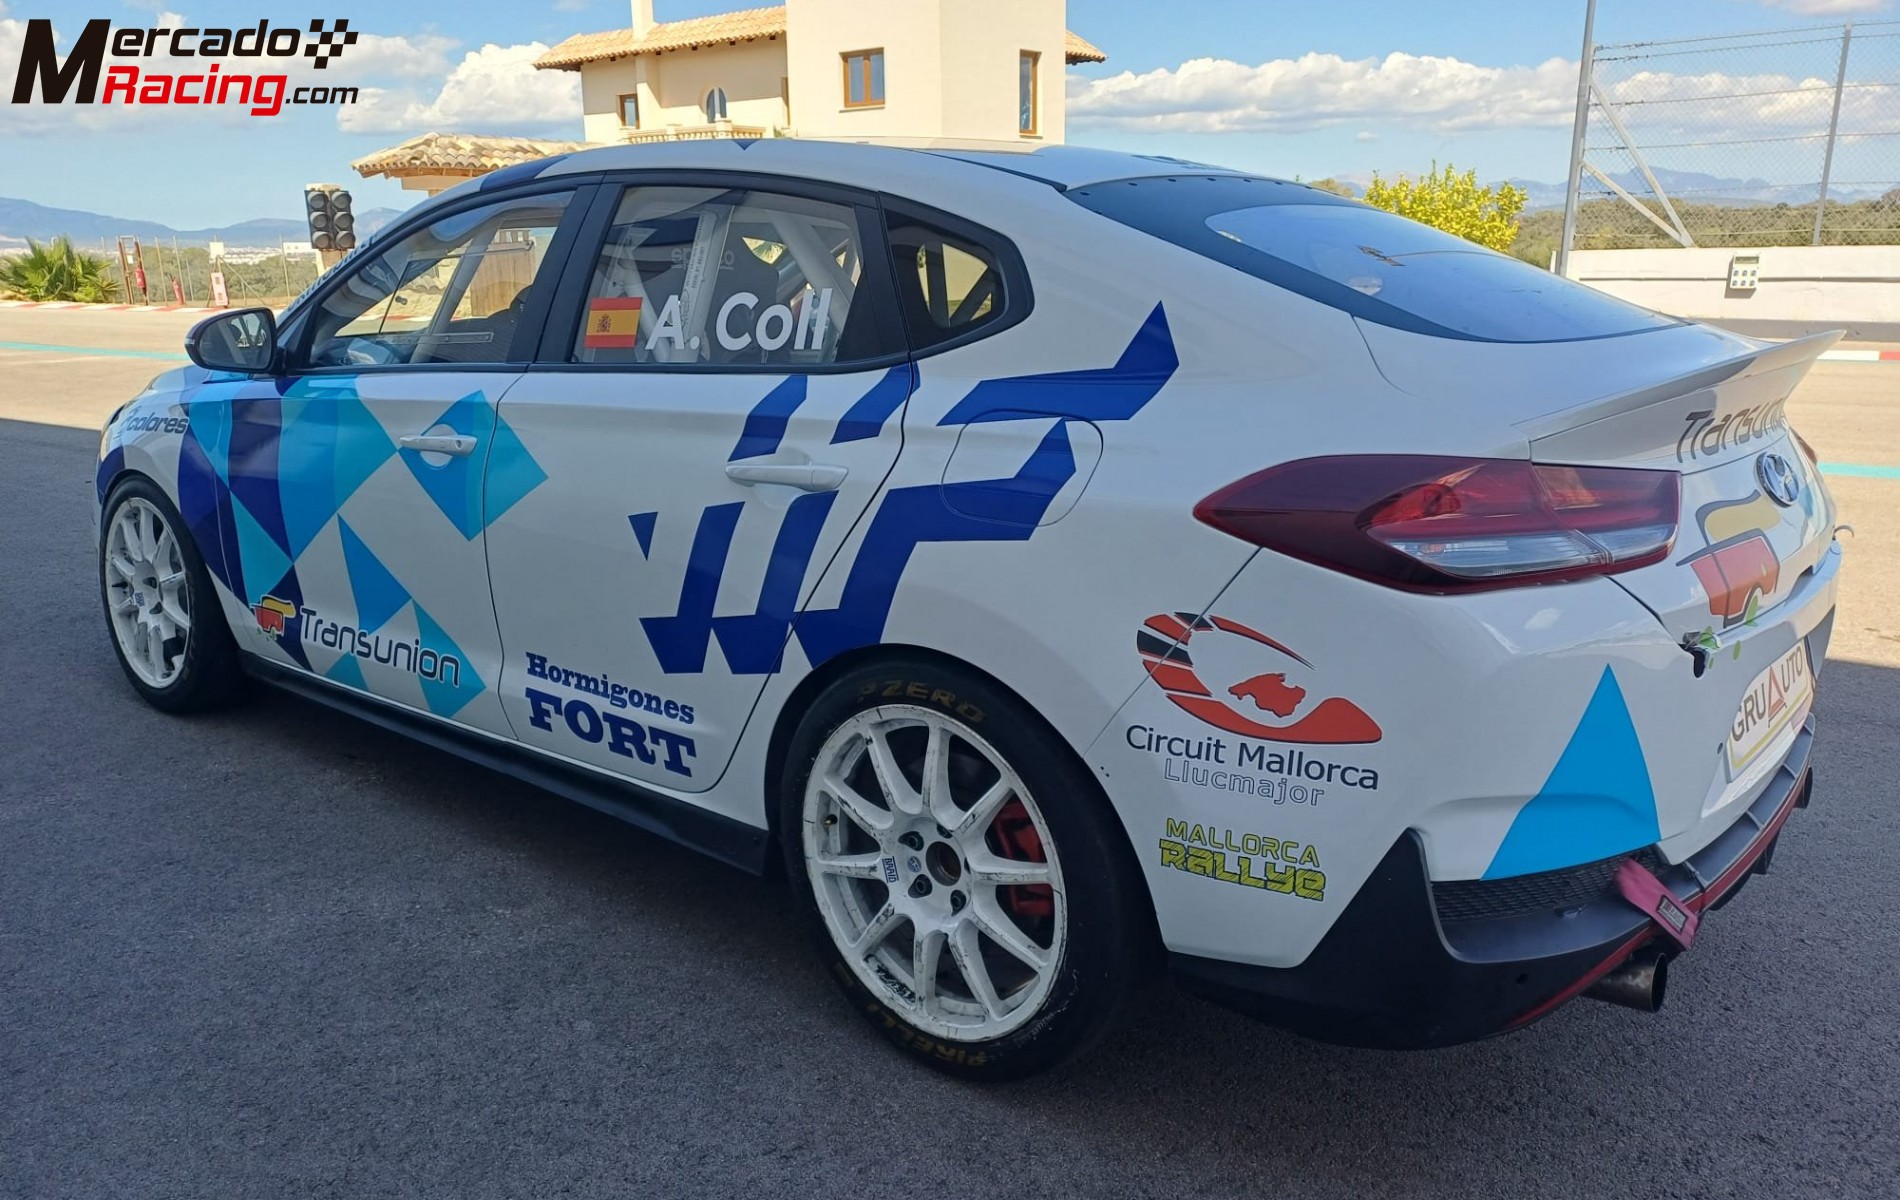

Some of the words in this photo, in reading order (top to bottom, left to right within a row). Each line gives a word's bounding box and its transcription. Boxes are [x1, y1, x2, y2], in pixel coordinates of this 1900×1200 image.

[645, 294, 701, 350] A.
[716, 288, 833, 350] Coll
[299, 607, 460, 688] Transunion
[525, 651, 696, 725] Hormigones
[525, 687, 697, 778] FORT
[1125, 724, 1226, 764] Circuit
[1237, 741, 1379, 790] Mallorca
[1163, 758, 1325, 806] Llucmajor
[884, 857, 897, 883] BRAID
[1166, 817, 1320, 868] MALLORCA
